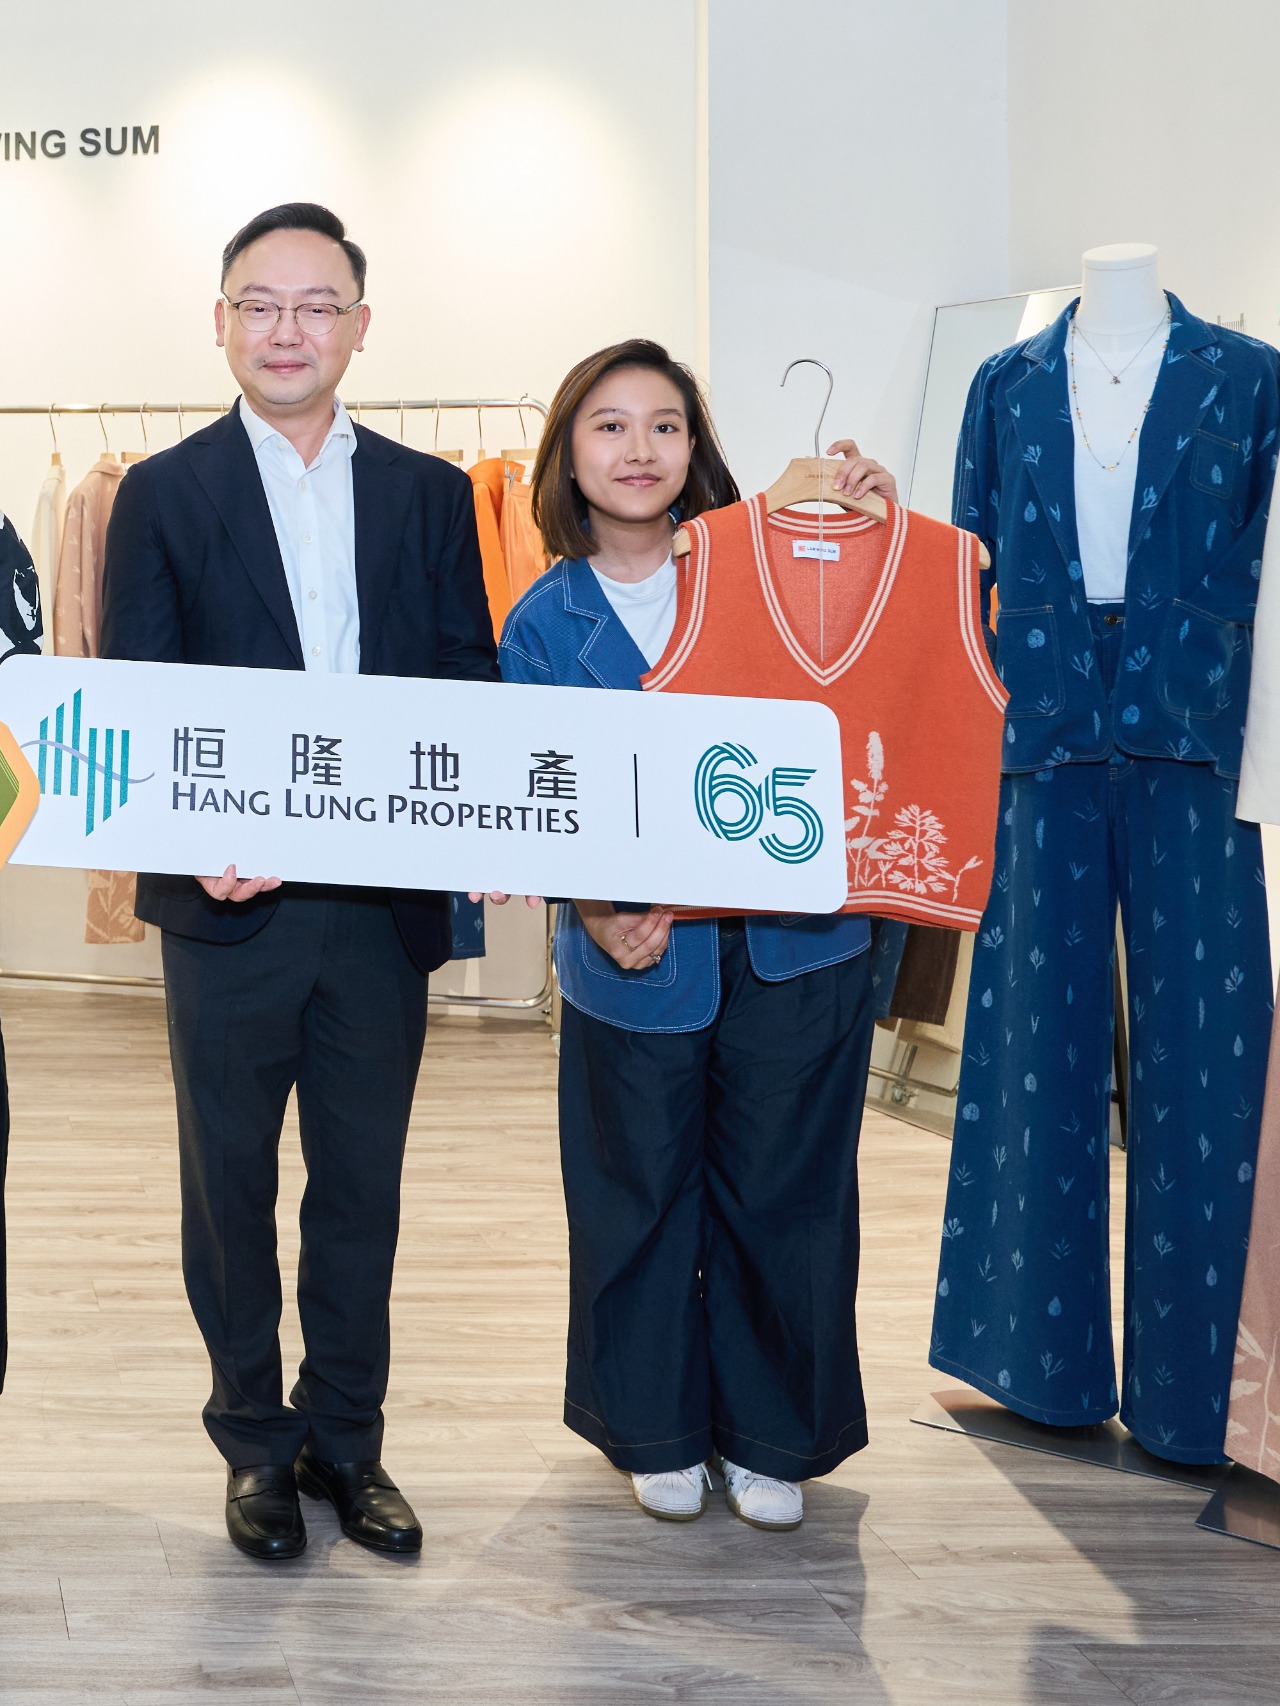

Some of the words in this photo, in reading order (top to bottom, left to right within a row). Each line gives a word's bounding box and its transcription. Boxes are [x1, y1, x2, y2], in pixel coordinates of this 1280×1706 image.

[80, 126, 160, 156] SUM
[172, 781, 270, 816] HANG
[285, 788, 377, 822] LUNG
[388, 794, 580, 835] PROPERTIES
[694, 741, 824, 865] 65
